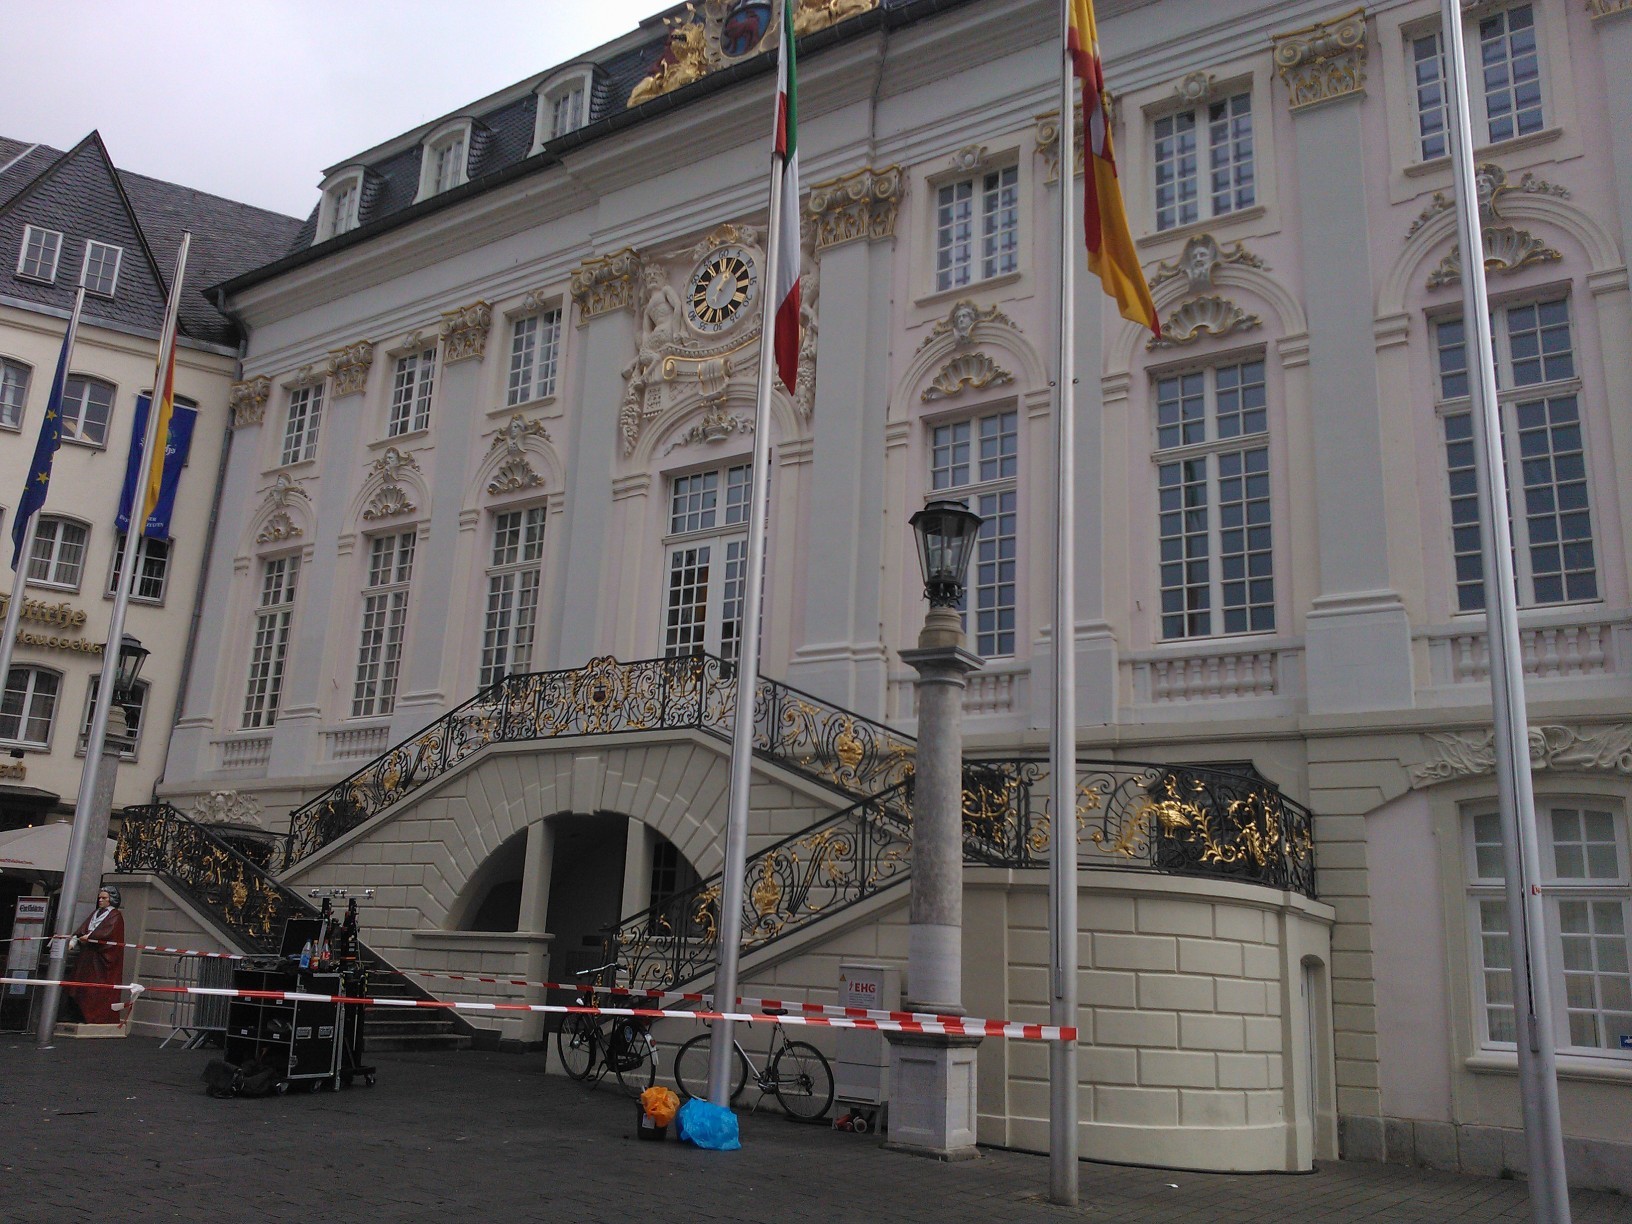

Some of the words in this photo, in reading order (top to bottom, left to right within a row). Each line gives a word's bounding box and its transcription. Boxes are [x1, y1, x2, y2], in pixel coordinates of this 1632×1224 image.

[719, 249, 729, 258] 60
[737, 249, 742, 257] 5
[750, 275, 757, 286] 15
[743, 294, 752, 307] 20
[730, 313, 740, 323] 25
[698, 323, 708, 331] 35
[713, 323, 722, 332] 30
[855, 982, 876, 993] EHG
